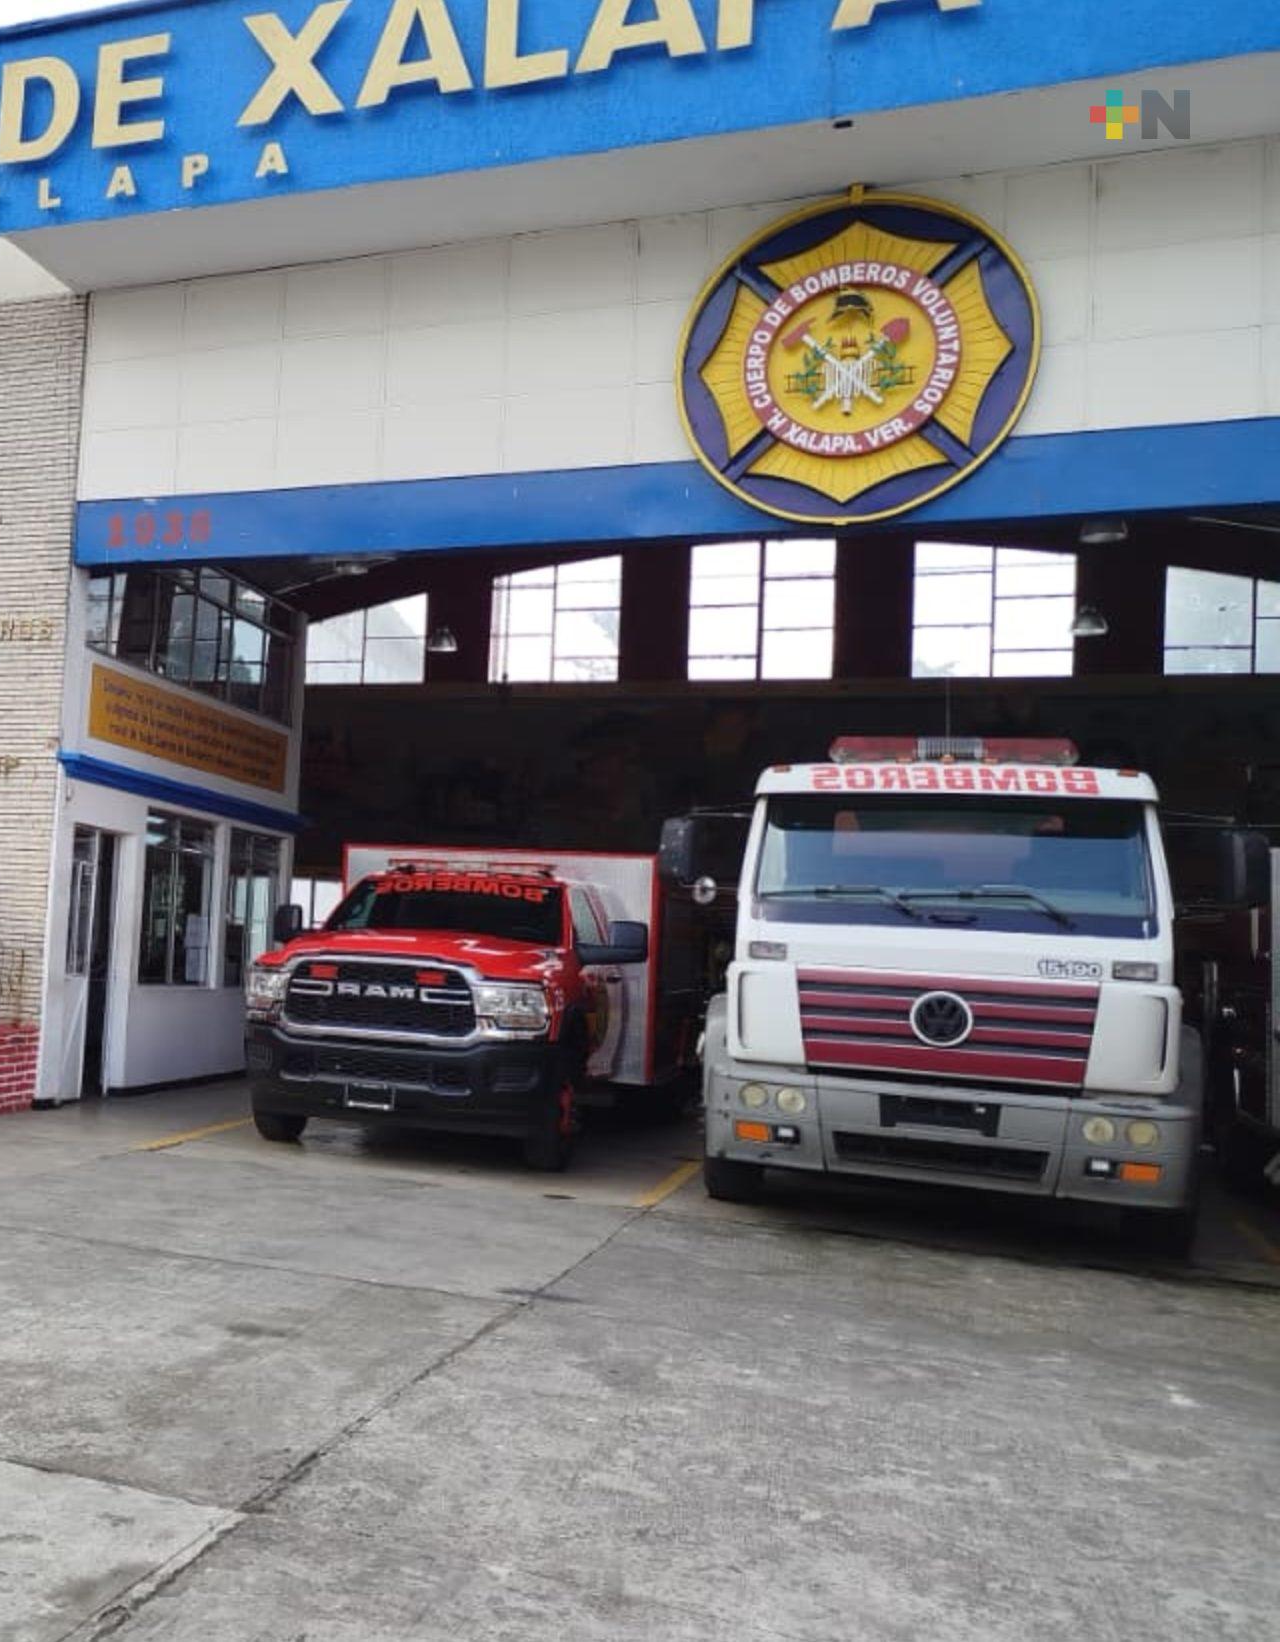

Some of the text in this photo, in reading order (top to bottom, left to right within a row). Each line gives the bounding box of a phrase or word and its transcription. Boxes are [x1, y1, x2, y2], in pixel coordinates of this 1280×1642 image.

[746, 329, 772, 409] CUERPO
[764, 298, 793, 326] DE
[789, 262, 912, 303] BOMBEROS
[911, 277, 961, 416] VOLUNTARIOS
[865, 418, 914, 448] VER.
[337, 982, 416, 1000] RAM
